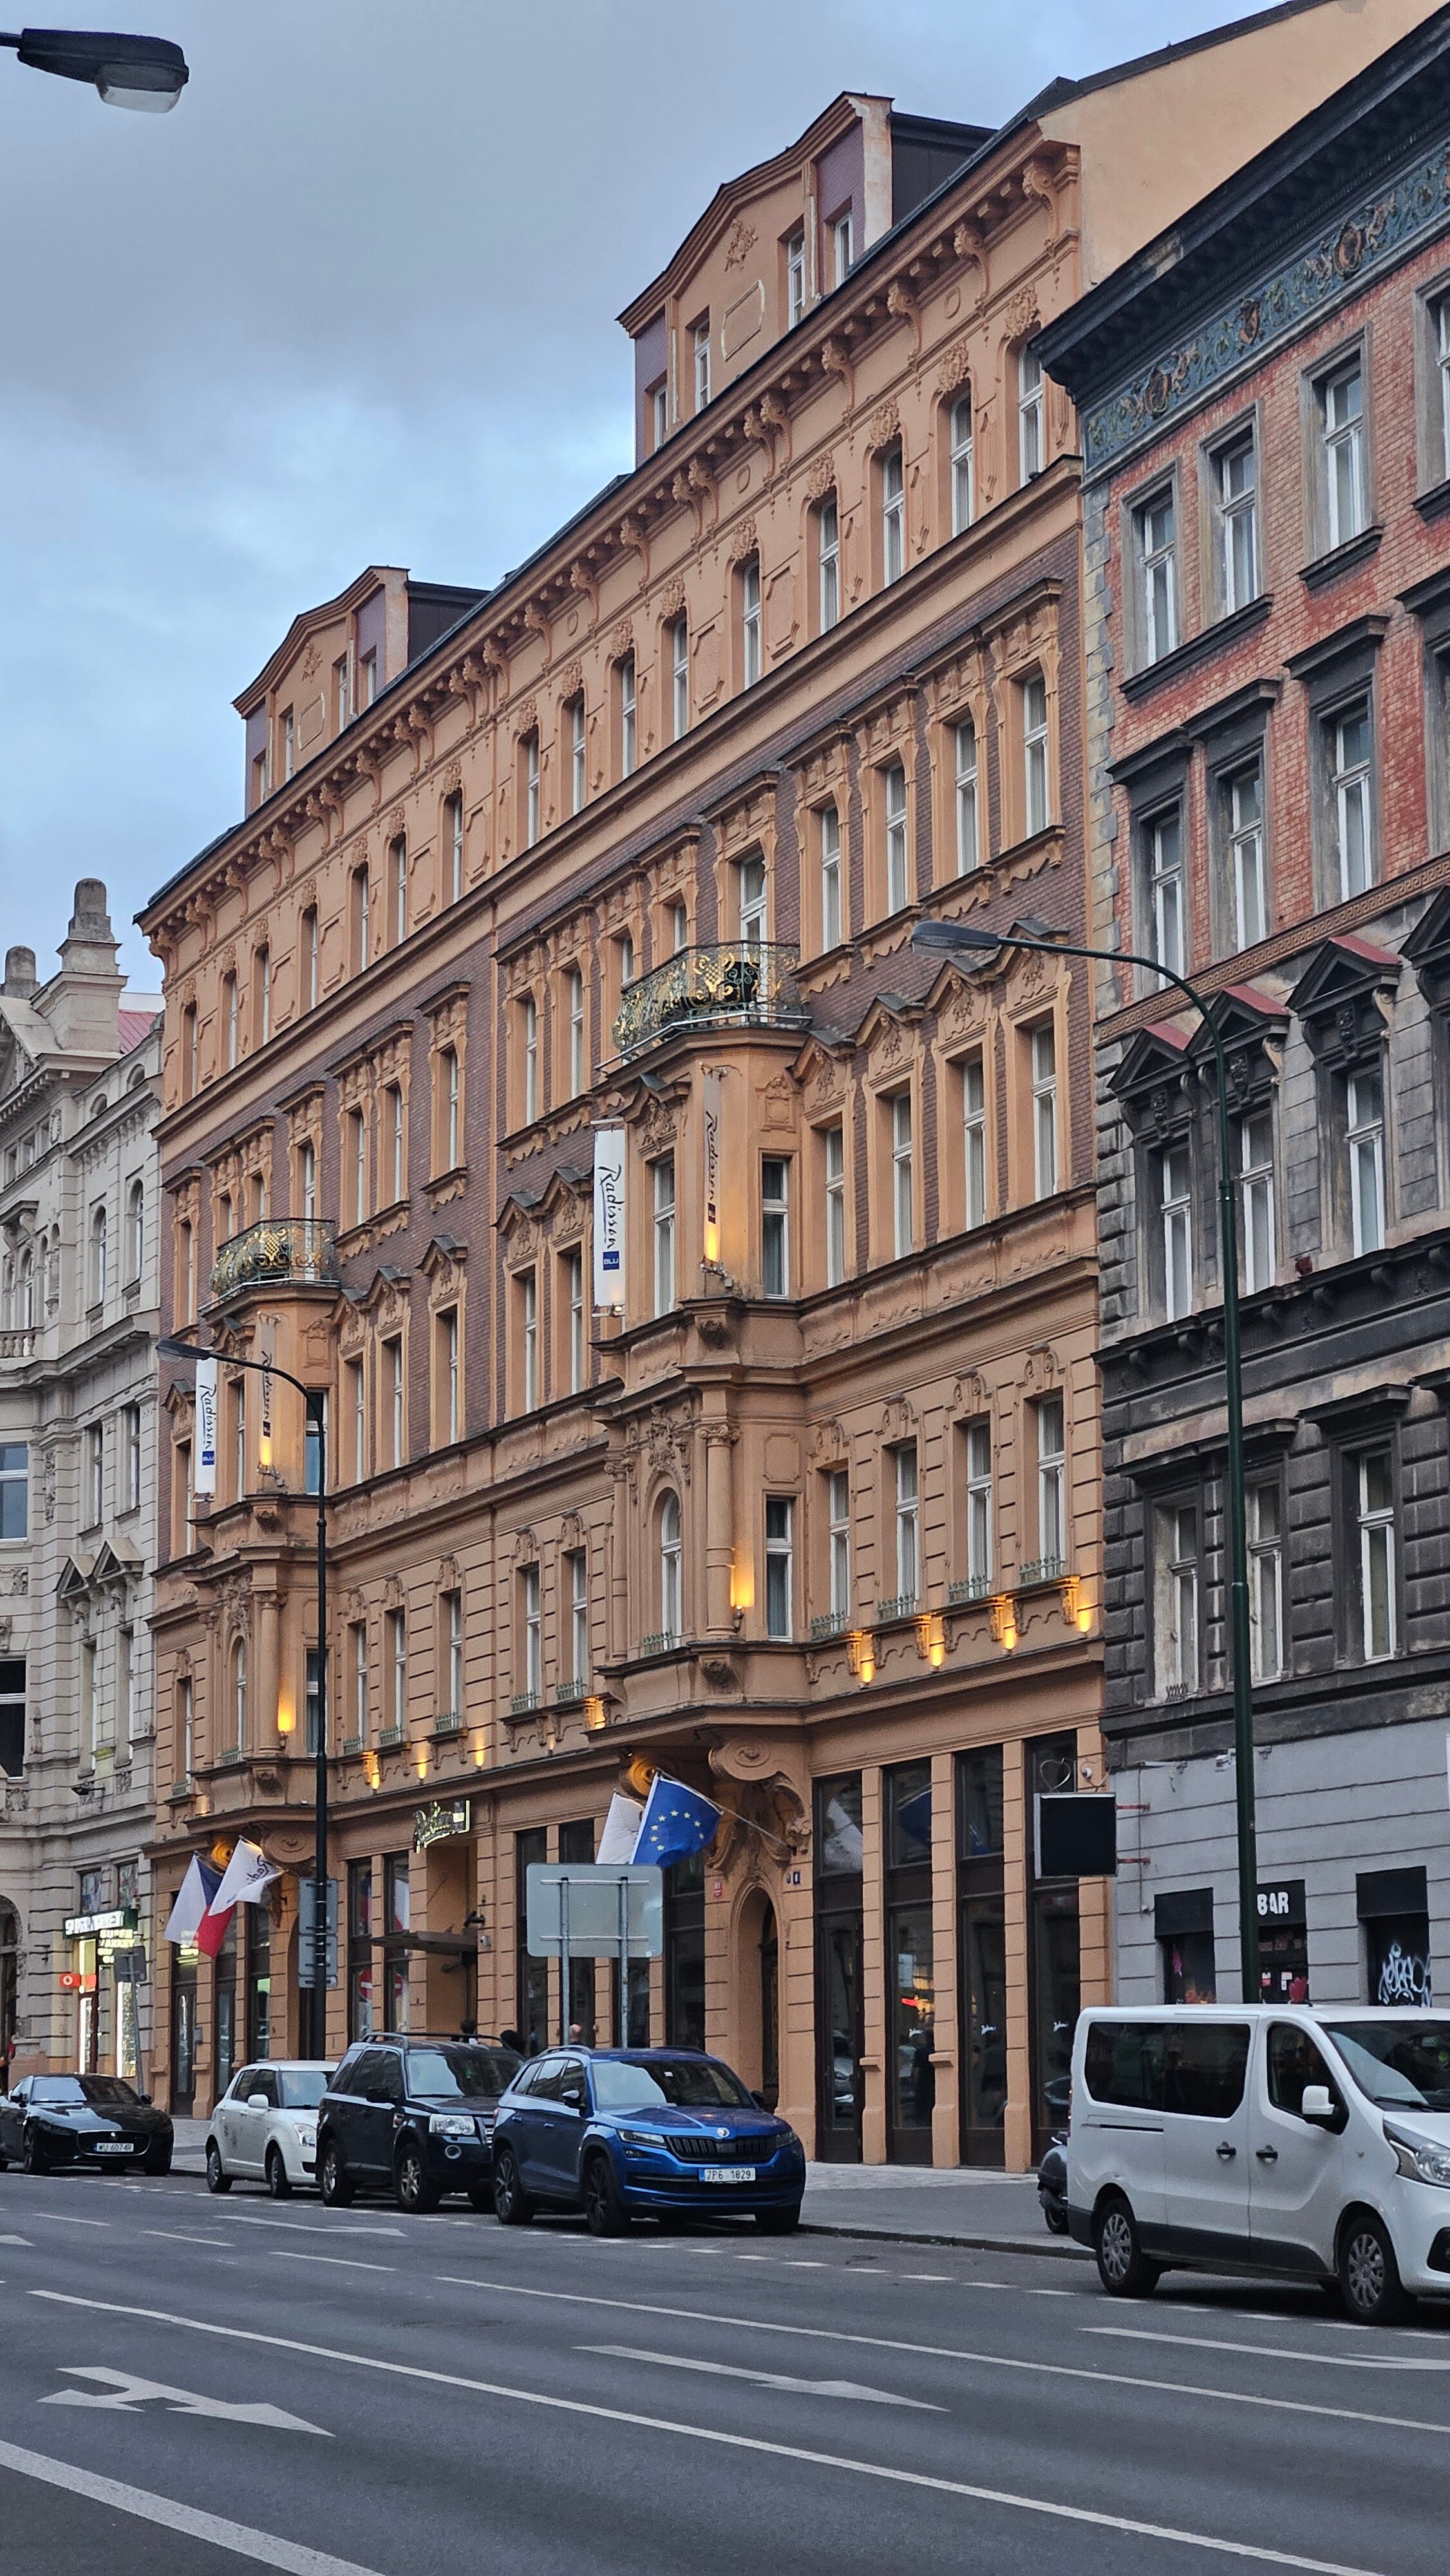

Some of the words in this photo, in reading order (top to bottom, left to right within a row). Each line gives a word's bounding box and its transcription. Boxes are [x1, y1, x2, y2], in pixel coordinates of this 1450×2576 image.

[597, 1164, 625, 1249] Radisson
[198, 1383, 217, 1449] Radisson
[1257, 1891, 1289, 1916] BAR
[100, 1929, 133, 1939] SUPER
[707, 2170, 724, 2180] 7P6
[731, 2170, 751, 2179] 1829
